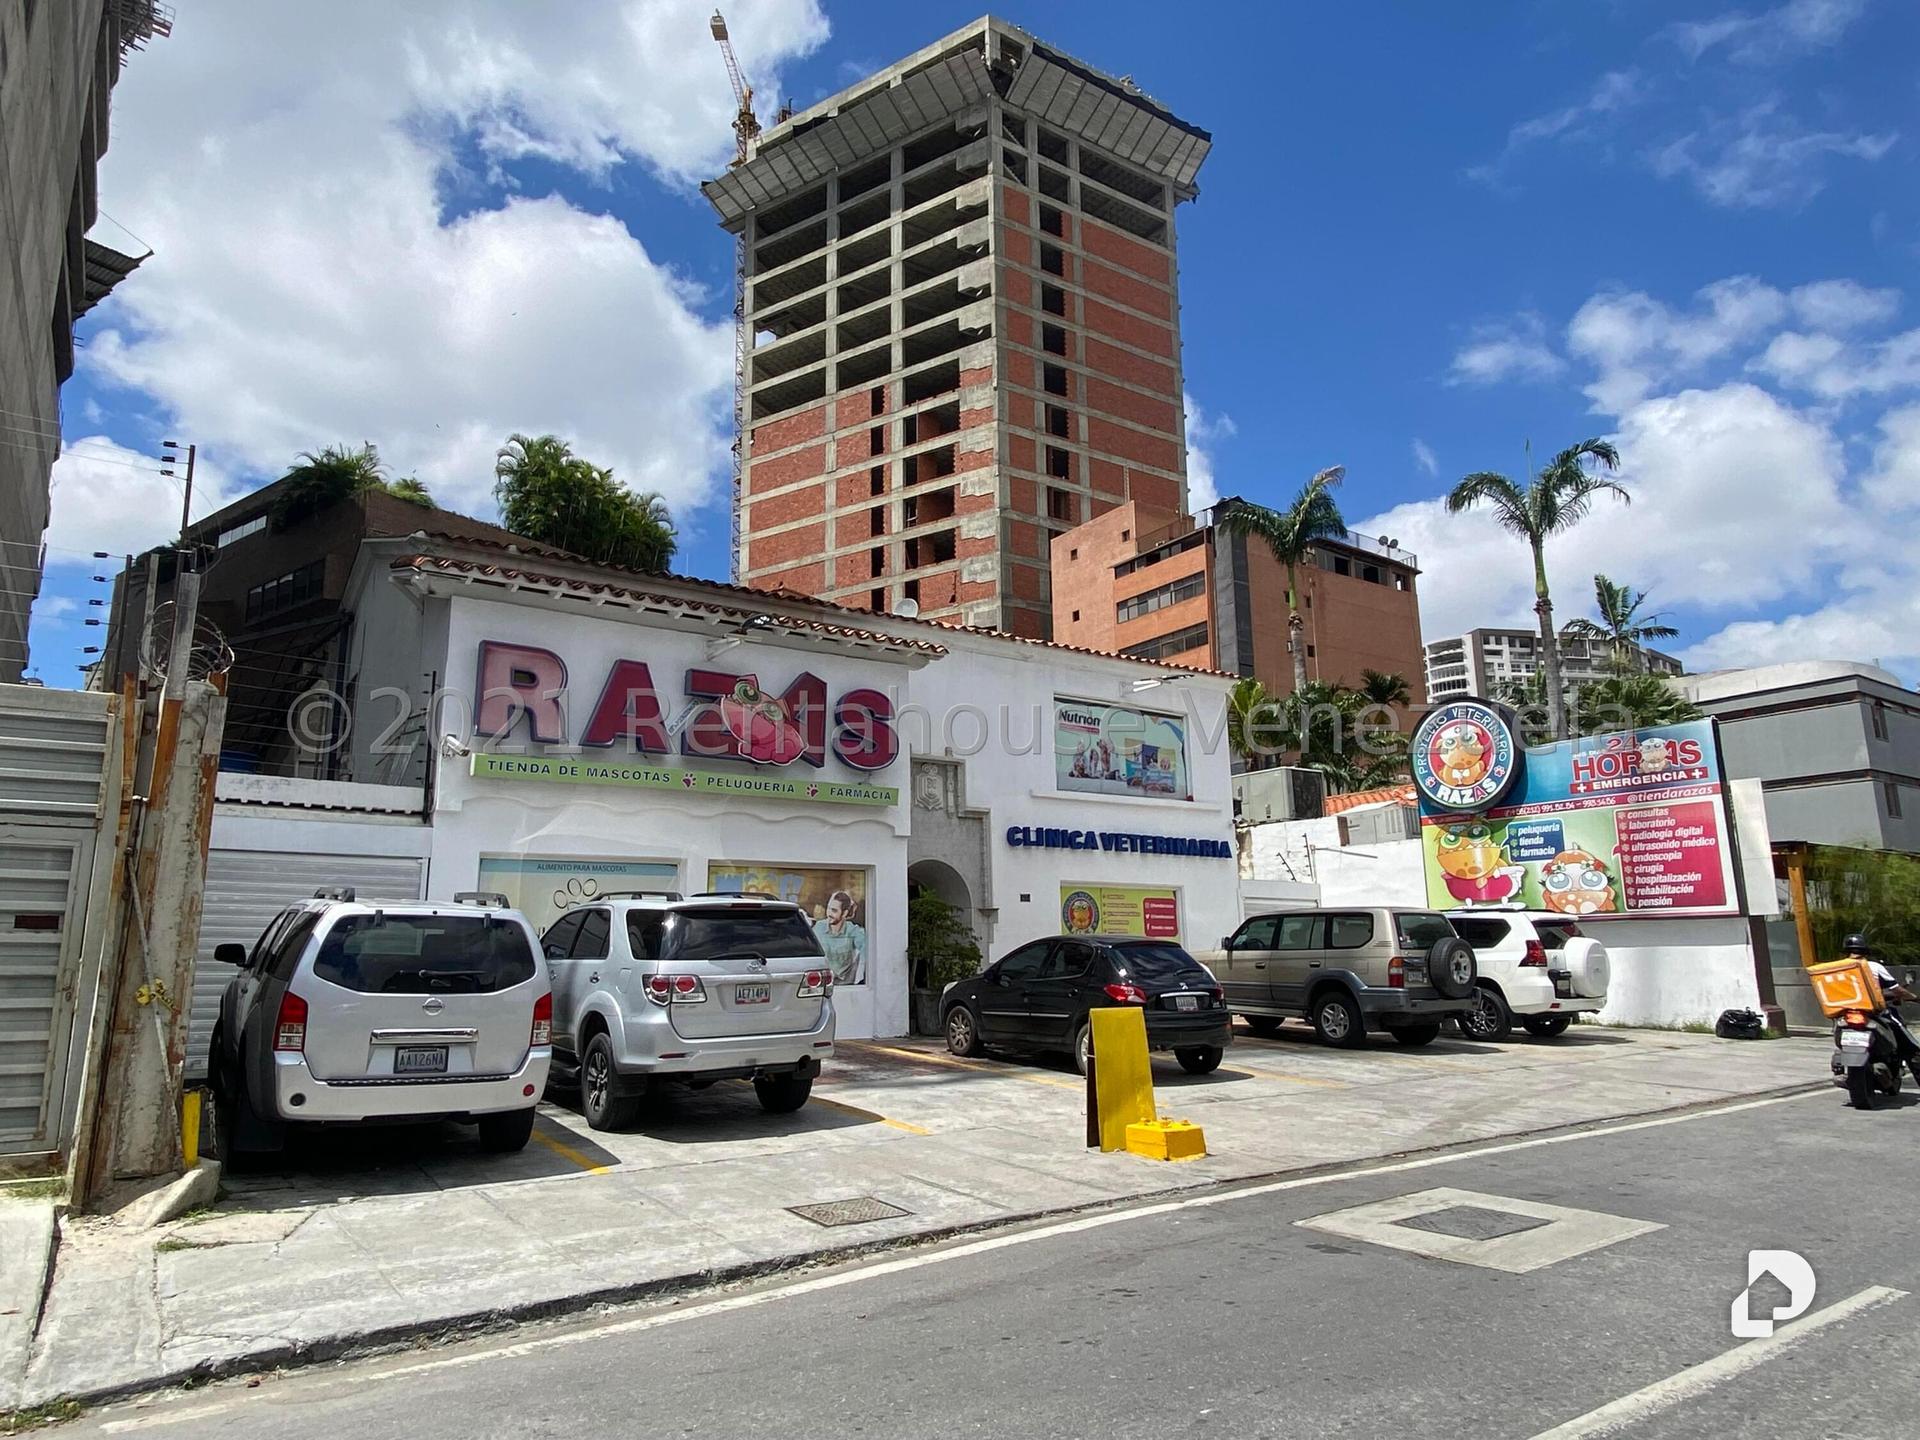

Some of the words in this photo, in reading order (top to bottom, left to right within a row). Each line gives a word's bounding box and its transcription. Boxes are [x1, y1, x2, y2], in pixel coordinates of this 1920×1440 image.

[474, 639, 900, 772] RAZAS
[1452, 707, 1507, 763] VETERINARIO
[1606, 735, 1640, 752] 24
[1572, 739, 1704, 782] HORAS
[487, 760, 551, 776] TIENDA
[558, 764, 580, 777] DE
[585, 767, 671, 784] MASCOTAS
[706, 776, 796, 794] PELUQUERIA
[829, 787, 892, 801] FARMACIA
[1592, 770, 1688, 790] EMERGENCIA
[1436, 778, 1497, 804] RAZAS
[1627, 785, 1713, 803] @tiendarazas
[1627, 808, 1670, 819] consultas
[1628, 818, 1676, 830] laboratorio
[1674, 826, 1704, 838] digital
[1006, 826, 1099, 851] CLINICA
[1099, 832, 1232, 858] VETERINARIA
[1519, 838, 1545, 847] tienda
[1631, 839, 1681, 851] ultrasonido
[1681, 837, 1716, 849] médico
[536, 863, 573, 872] ALIMENTO
[573, 864, 591, 873] PARA
[591, 864, 628, 874] MASCOTAS
[1635, 872, 1702, 885] hospitalización
[1636, 884, 1695, 896] rehabilitación
[1637, 896, 1673, 908] pensión
